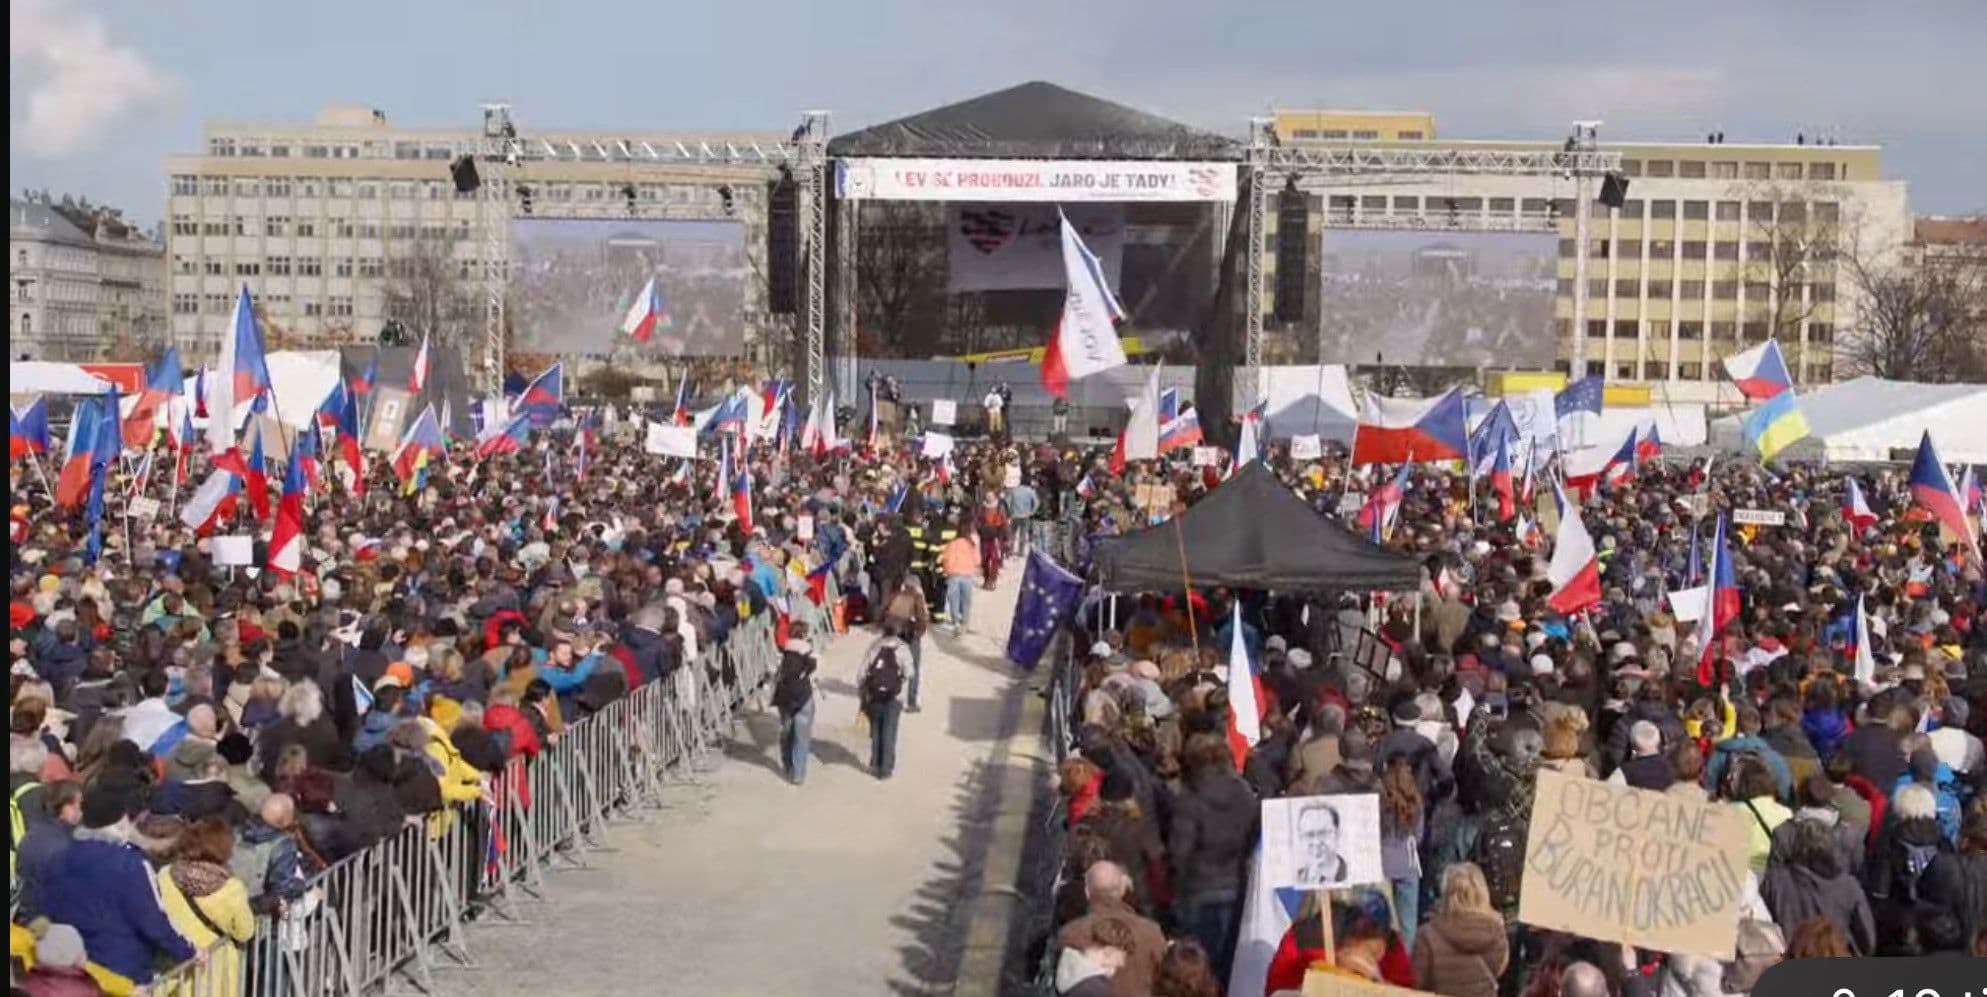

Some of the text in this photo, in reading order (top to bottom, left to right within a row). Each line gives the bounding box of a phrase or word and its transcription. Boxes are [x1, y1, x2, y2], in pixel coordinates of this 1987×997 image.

[1049, 172, 1095, 188] JARO
[1100, 172, 1121, 189] JE
[1125, 172, 1176, 189] TADY!
[1593, 828, 1689, 872] PROTI
